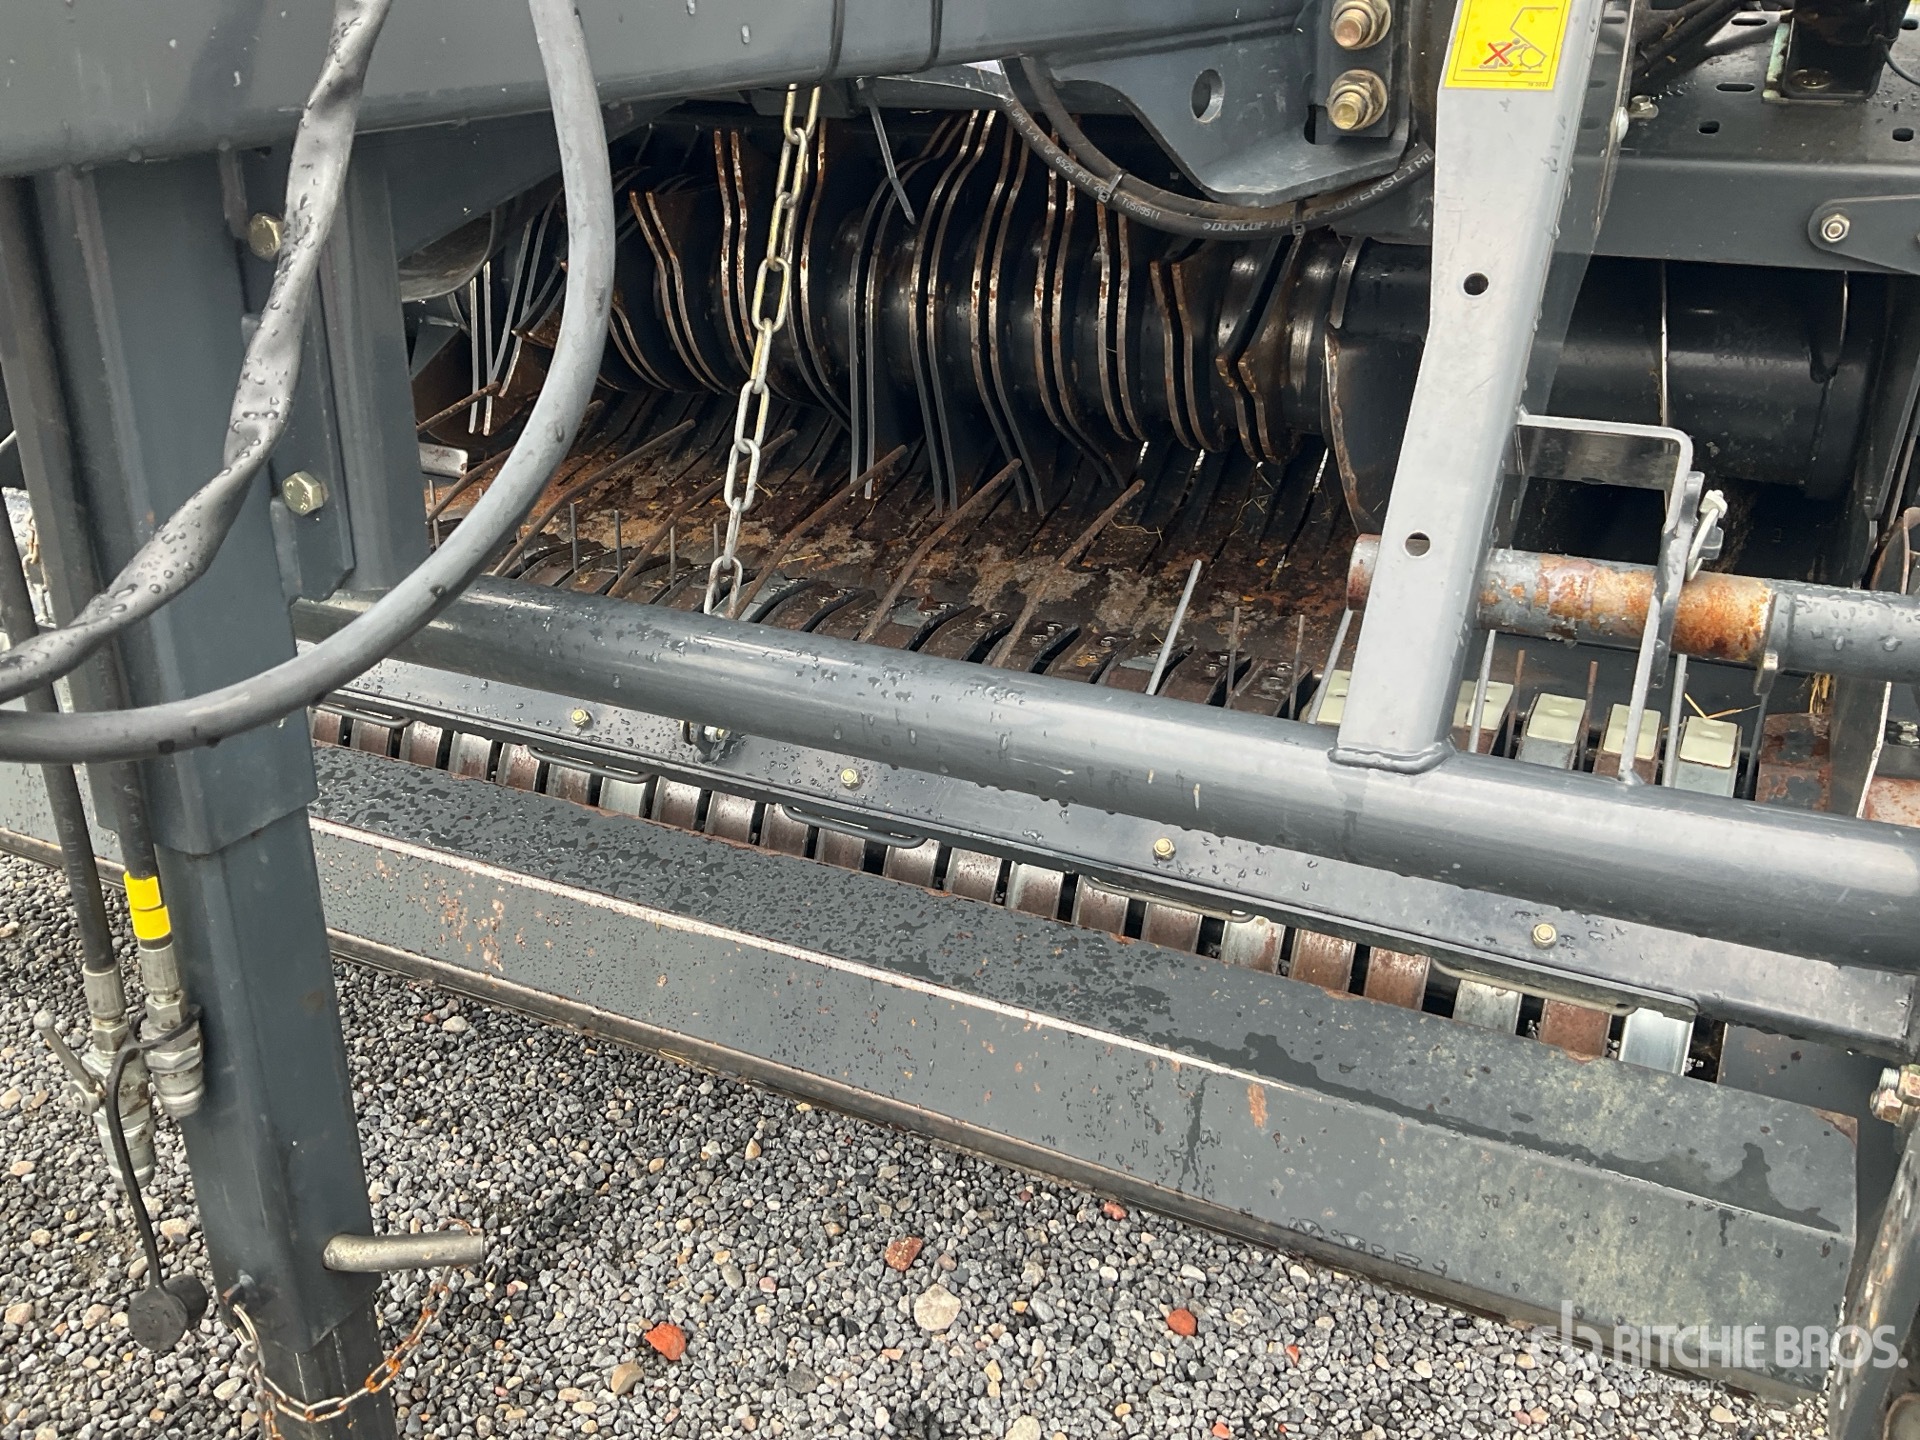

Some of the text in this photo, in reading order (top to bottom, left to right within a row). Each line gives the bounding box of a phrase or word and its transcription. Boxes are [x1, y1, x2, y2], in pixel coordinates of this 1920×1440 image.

[1055, 155, 1075, 174] 6525
[1075, 171, 1092, 186] PSI
[1211, 221, 1268, 232] DUNLOP
